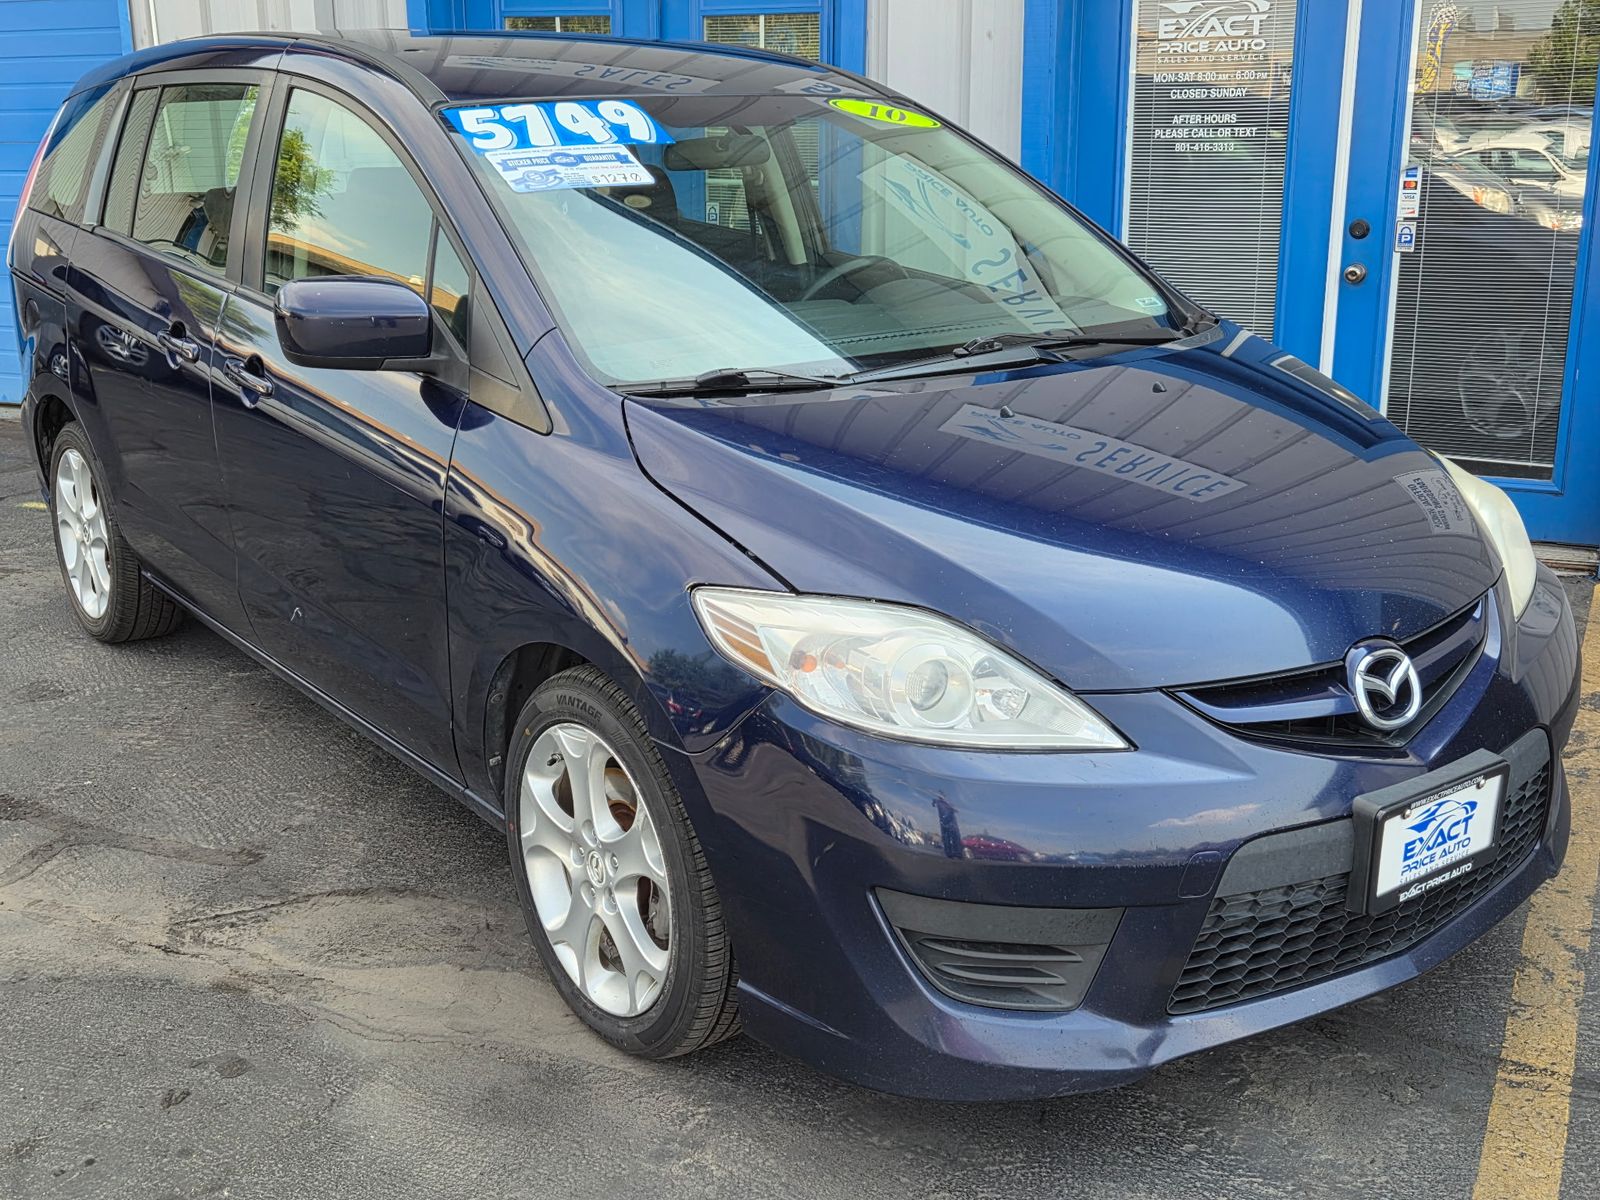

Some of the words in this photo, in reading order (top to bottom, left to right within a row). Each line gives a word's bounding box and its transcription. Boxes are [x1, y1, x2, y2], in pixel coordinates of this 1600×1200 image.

[1158, 13, 1268, 39] EXACT
[1157, 40, 1210, 54] PRICE
[1214, 38, 1266, 52] AUTO
[1157, 56, 1189, 64] SALES
[1221, 53, 1265, 62] SERVICE
[1153, 73, 1195, 83] MON-SAT
[1197, 72, 1216, 82] 8:00
[1236, 71, 1255, 80] 6:00
[1170, 88, 1208, 99] CLOSED
[1209, 87, 1248, 98] SUNDAY
[869, 105, 908, 122] 10
[1172, 115, 1202, 125] AFTER
[1204, 114, 1237, 123] HOURS
[458, 100, 656, 150] 5749
[1154, 129, 1190, 139] PLEASE
[1191, 128, 1216, 138] CALL
[1217, 128, 1232, 137] OR
[1233, 127, 1258, 137] TEXT
[1175, 142, 1234, 152] 801-416-3313
[583, 152, 618, 163] GUARANTEE
[556, 694, 602, 722] VANTAGE
[1403, 813, 1474, 862] EXACT
[1401, 854, 1435, 876] PRICE
[1439, 837, 1471, 859] AUTO
[1400, 883, 1427, 902] EXACT
[1427, 872, 1450, 889] PRICE
[1451, 863, 1472, 878] AUTO
